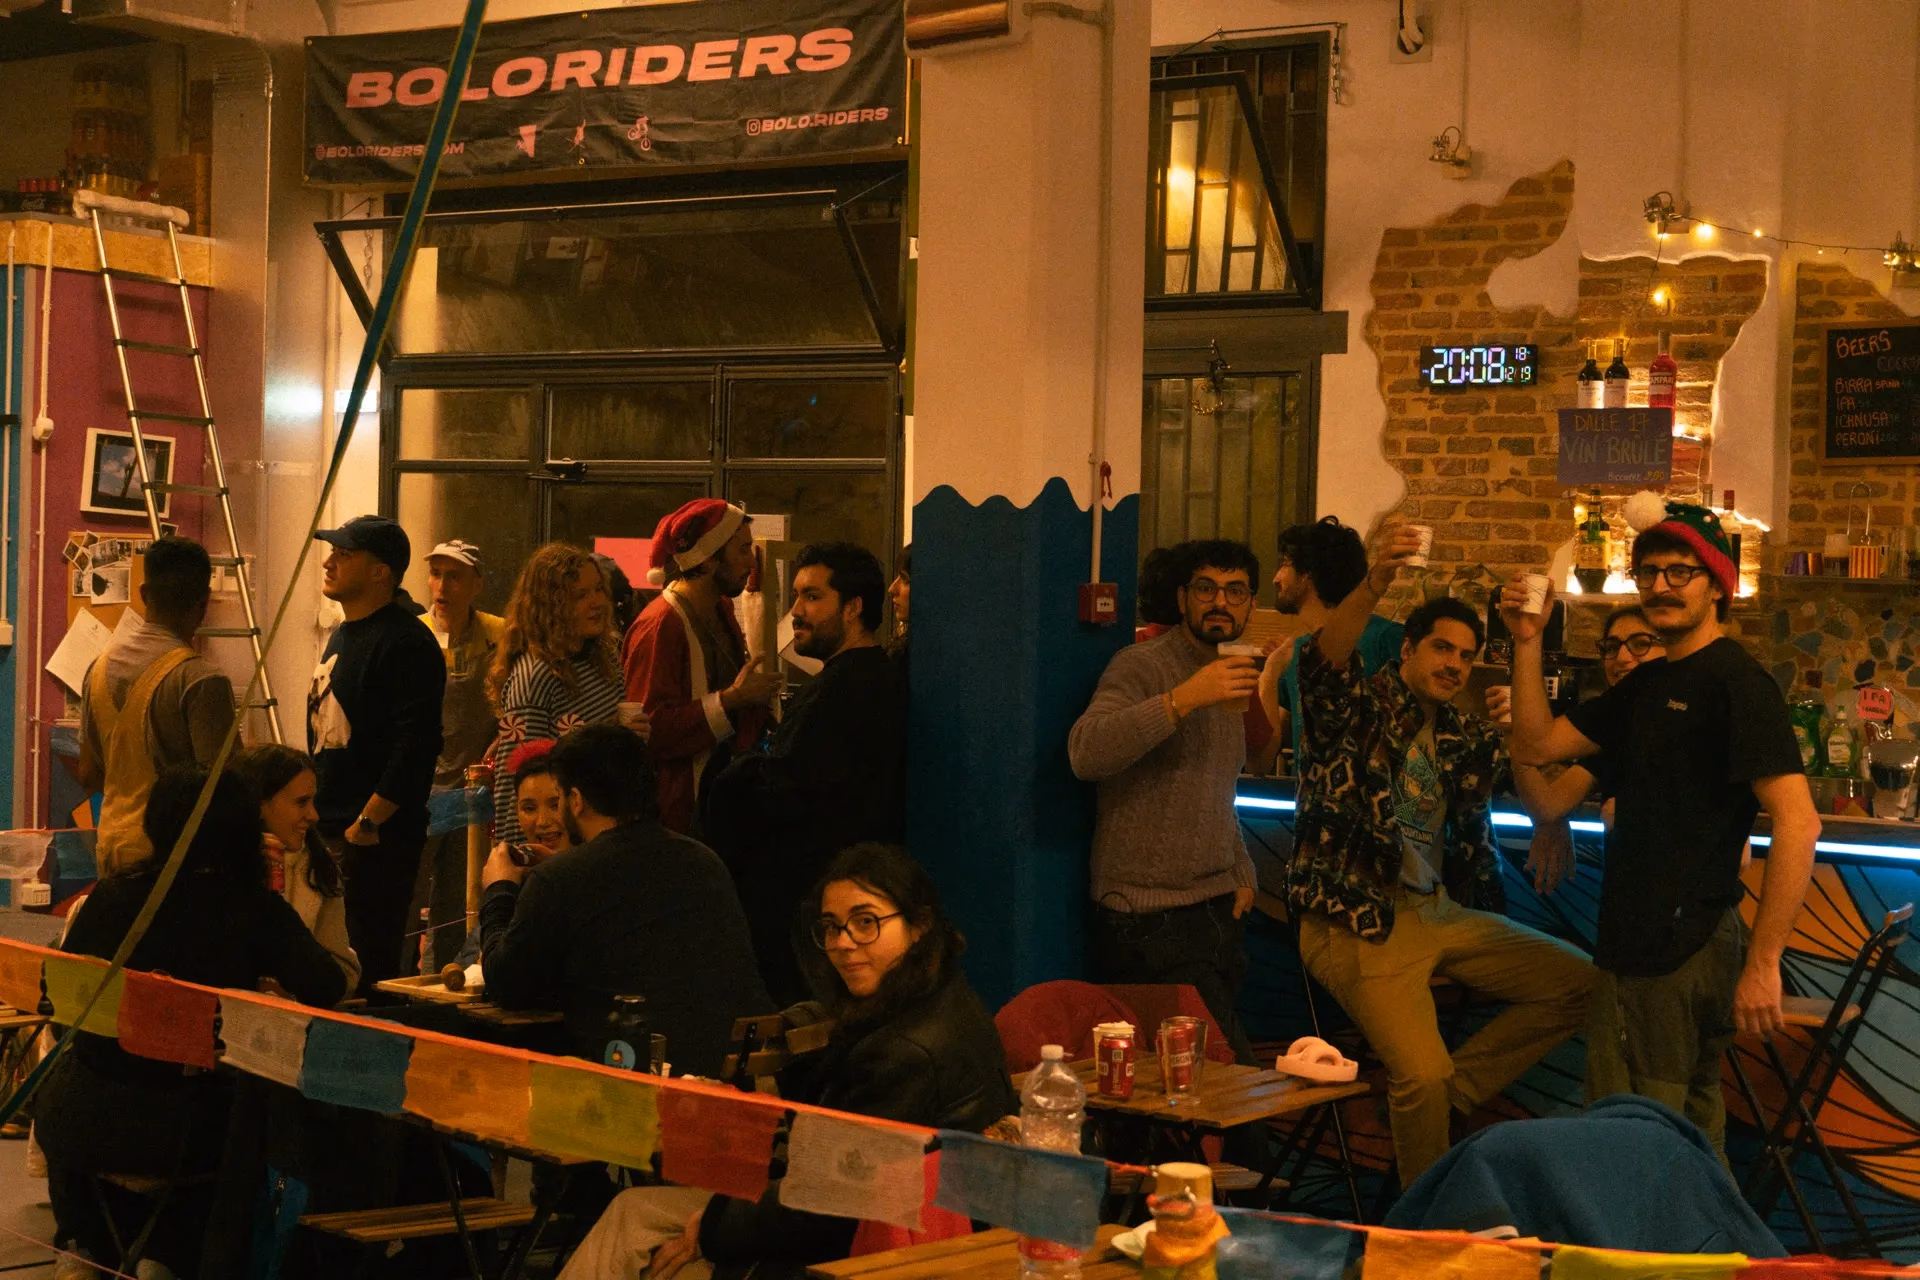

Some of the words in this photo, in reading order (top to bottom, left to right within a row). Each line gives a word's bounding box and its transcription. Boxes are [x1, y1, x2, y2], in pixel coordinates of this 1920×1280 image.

[345, 27, 854, 109] BOLORIDERS
[761, 107, 889, 134] BOLO.RIDERS
[326, 141, 465, 160] BOLORIDERSOM
[1837, 330, 1892, 358] BEERS
[1430, 346, 1505, 384] 20:08
[1649, 376, 1674, 385] AMPARI
[1836, 396, 1856, 411] IPA
[1574, 412, 1621, 432] DALLE
[1627, 412, 1651, 435] 17
[1835, 411, 1889, 429] ICHNUSA
[1562, 434, 1599, 465] VIN
